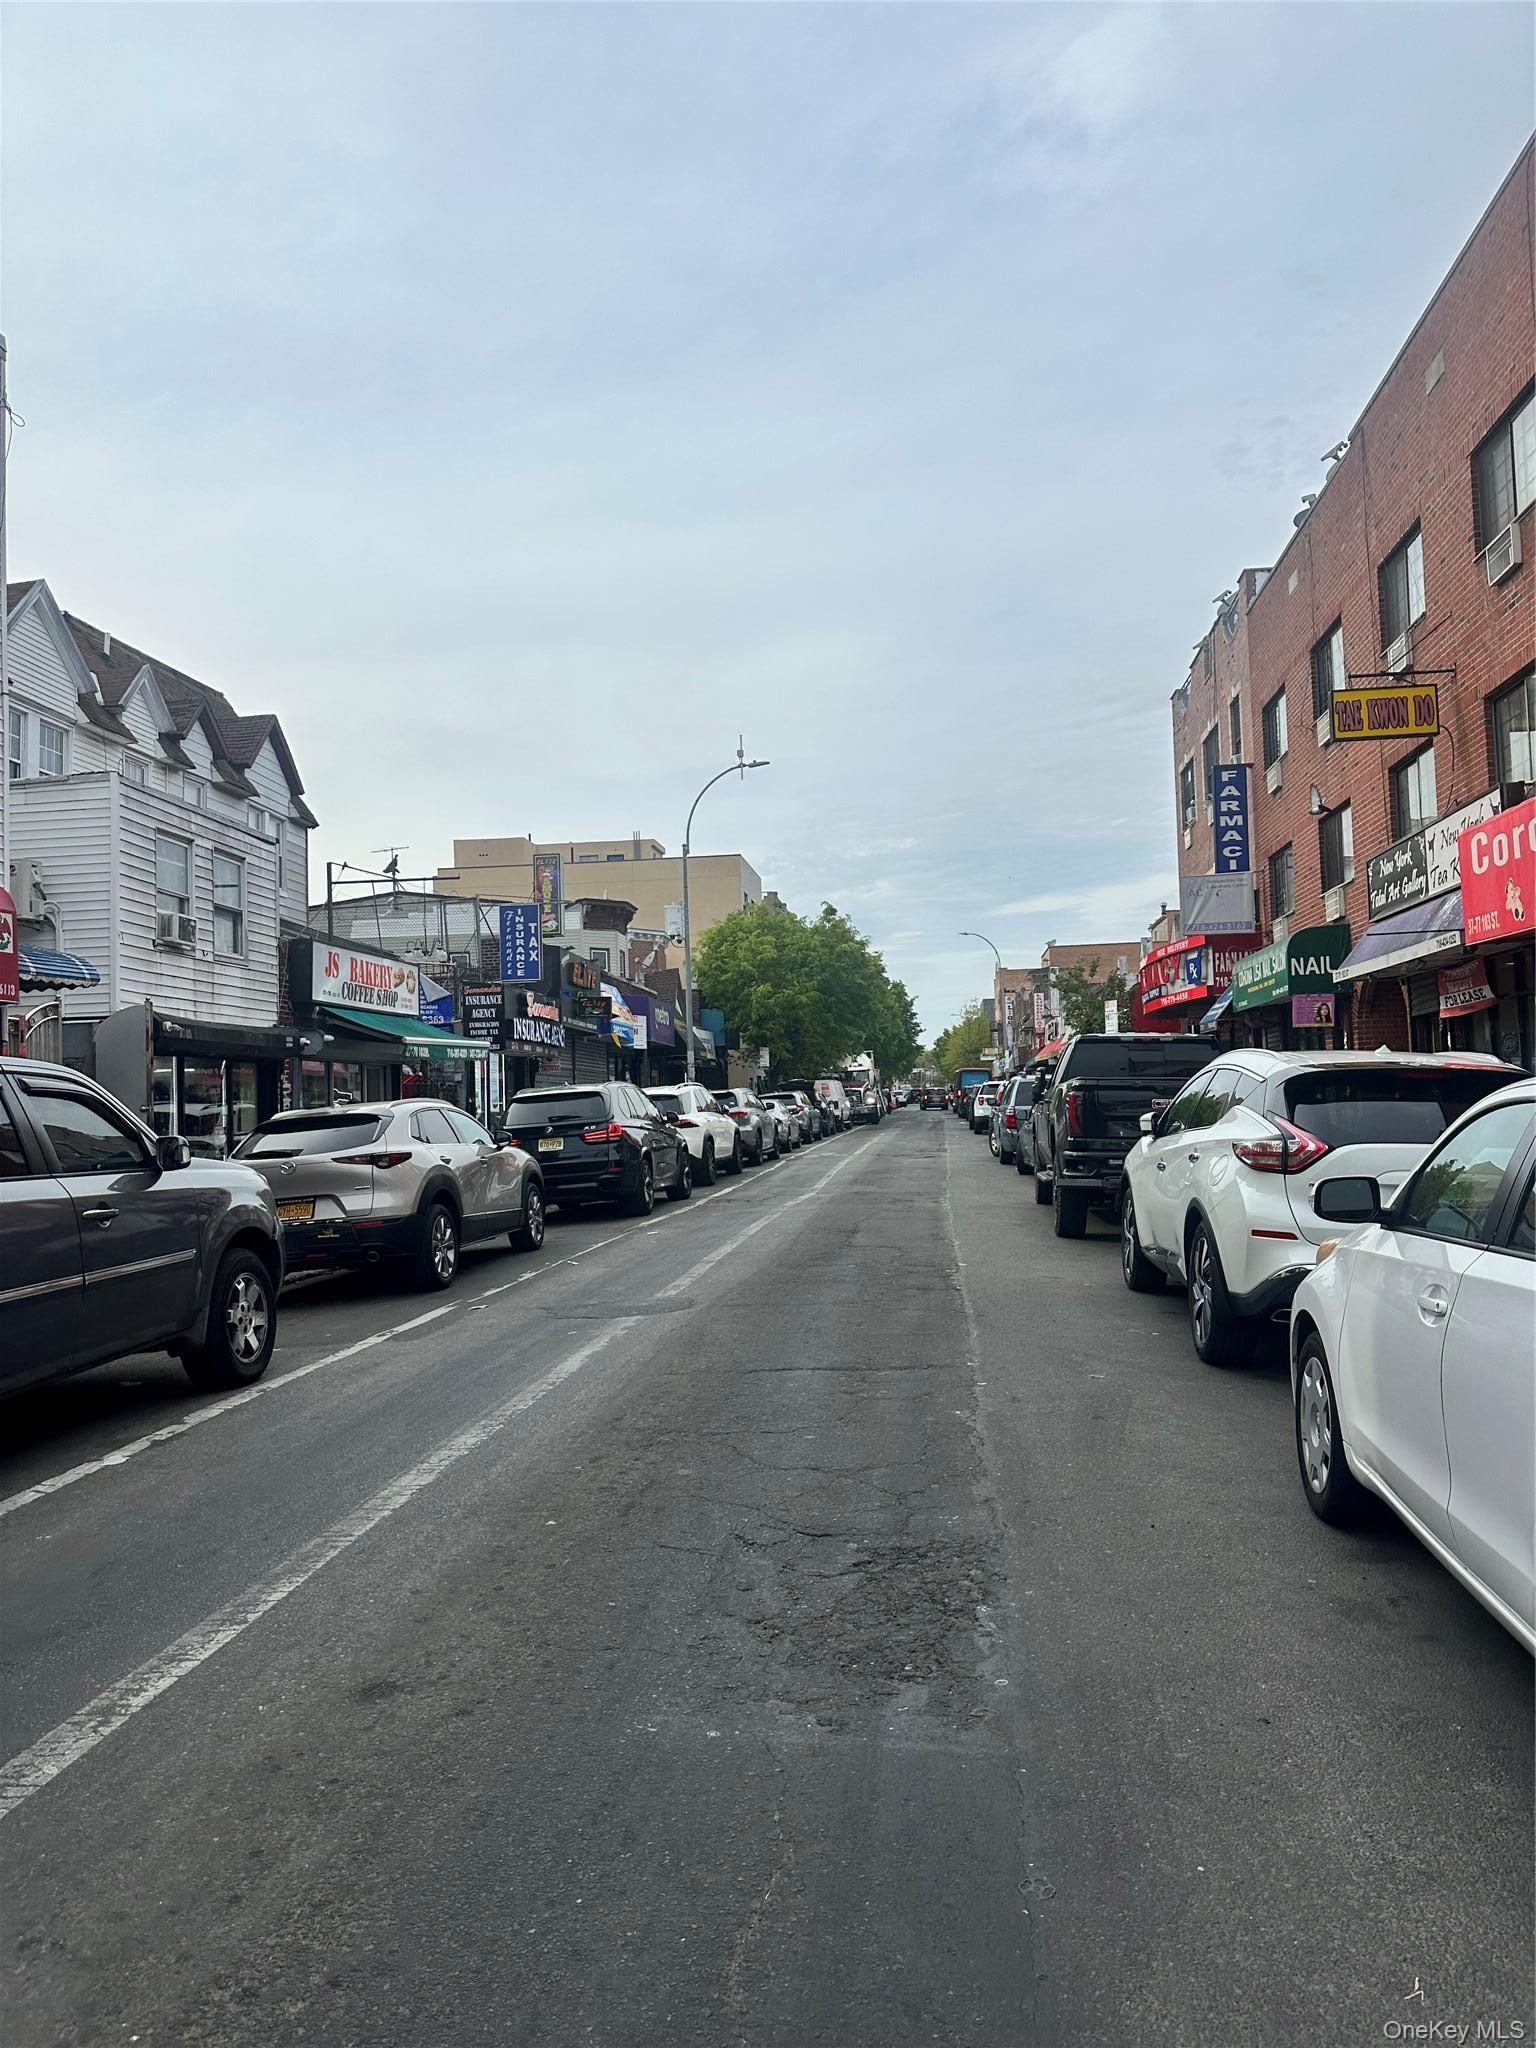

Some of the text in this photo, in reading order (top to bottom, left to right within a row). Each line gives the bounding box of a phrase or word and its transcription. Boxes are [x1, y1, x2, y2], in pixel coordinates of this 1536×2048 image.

[1335, 694, 1435, 732] TAE KWON DO
[1379, 841, 1413, 878] New York
[1430, 864, 1448, 889] Tea
[504, 911, 514, 975] Fernandez
[515, 909, 526, 977] INSURANCE
[528, 922, 538, 962] TAX
[325, 951, 340, 979] JS
[350, 957, 394, 990] BAKERY
[342, 981, 375, 1005] COFFEE
[376, 988, 399, 1008] SHOP
[465, 995, 502, 1006] INSURANCE
[1444, 988, 1487, 1008] FOR LEASE
[471, 1008, 496, 1019] AGENCY
[513, 1018, 551, 1045] INSURANCE
